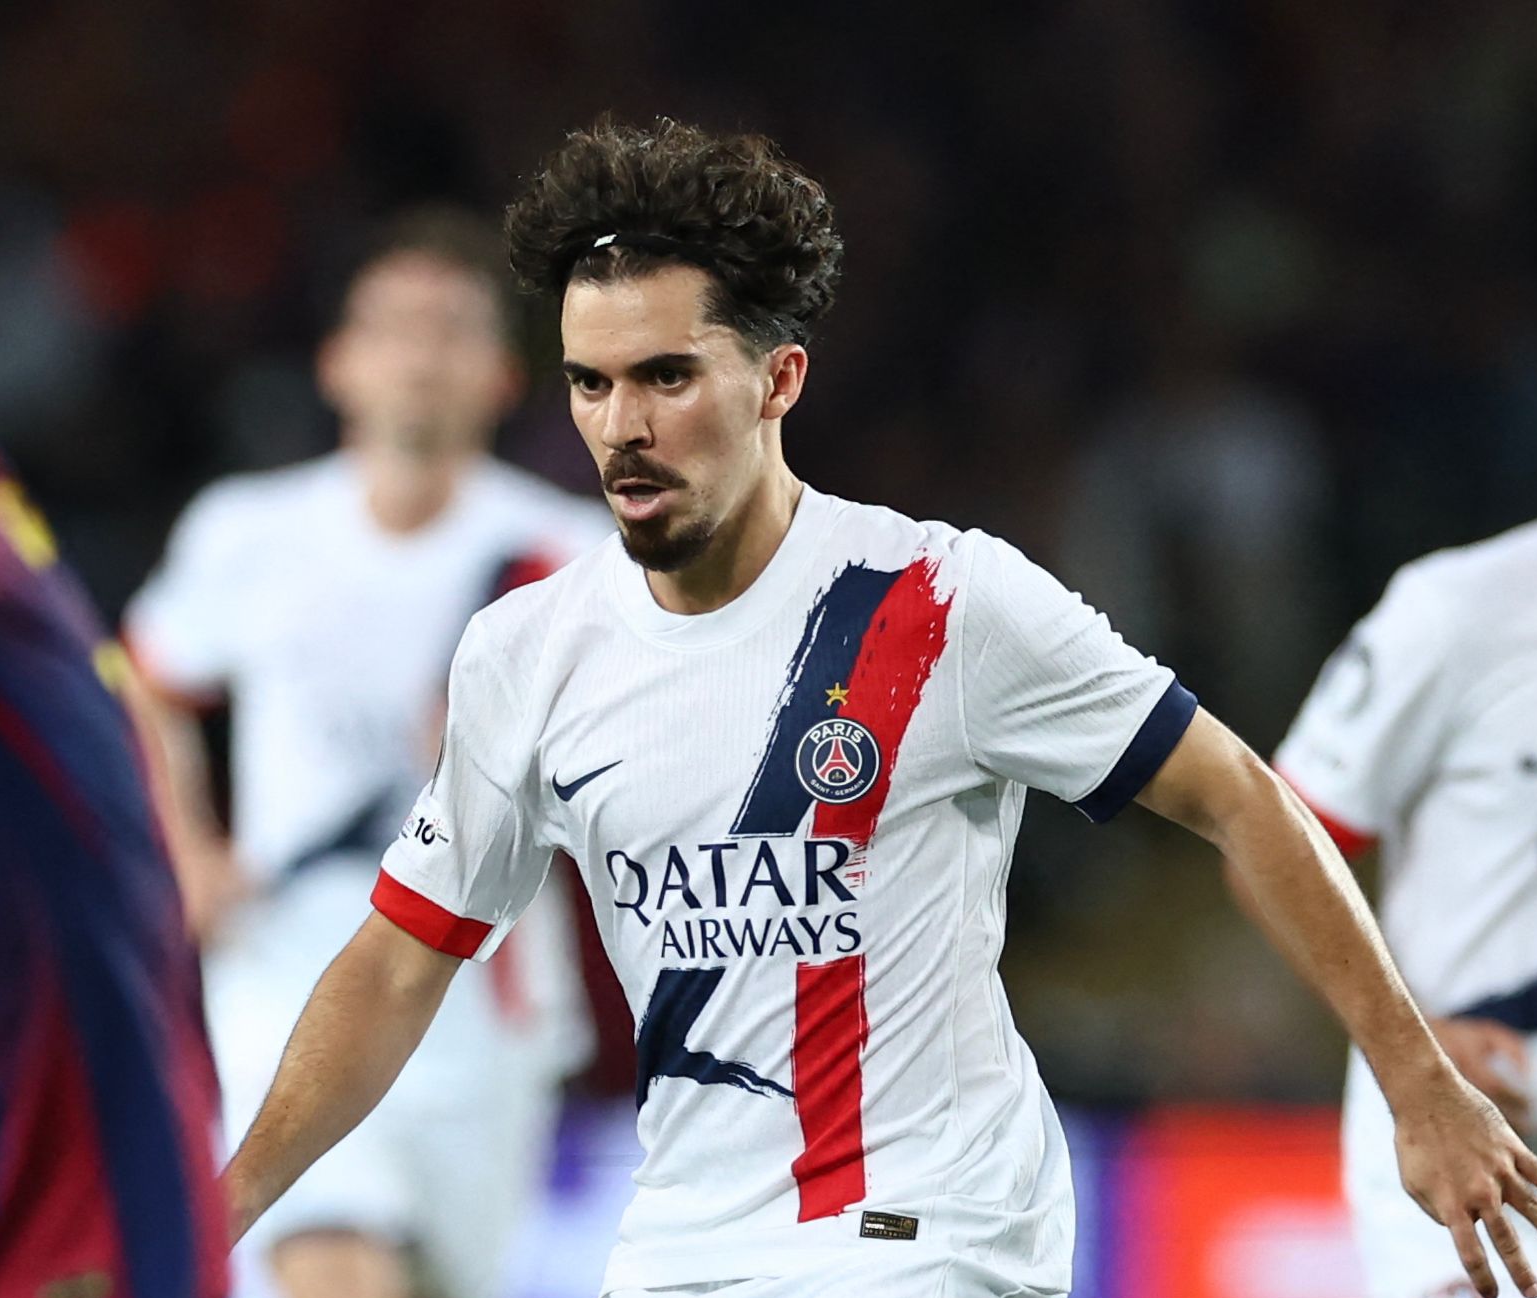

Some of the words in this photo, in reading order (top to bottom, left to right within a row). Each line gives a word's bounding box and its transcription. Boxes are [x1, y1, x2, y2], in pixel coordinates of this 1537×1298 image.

[809, 722, 865, 744] PARIS
[606, 839, 858, 928] QATAR
[660, 911, 862, 959] AIRWAYS
